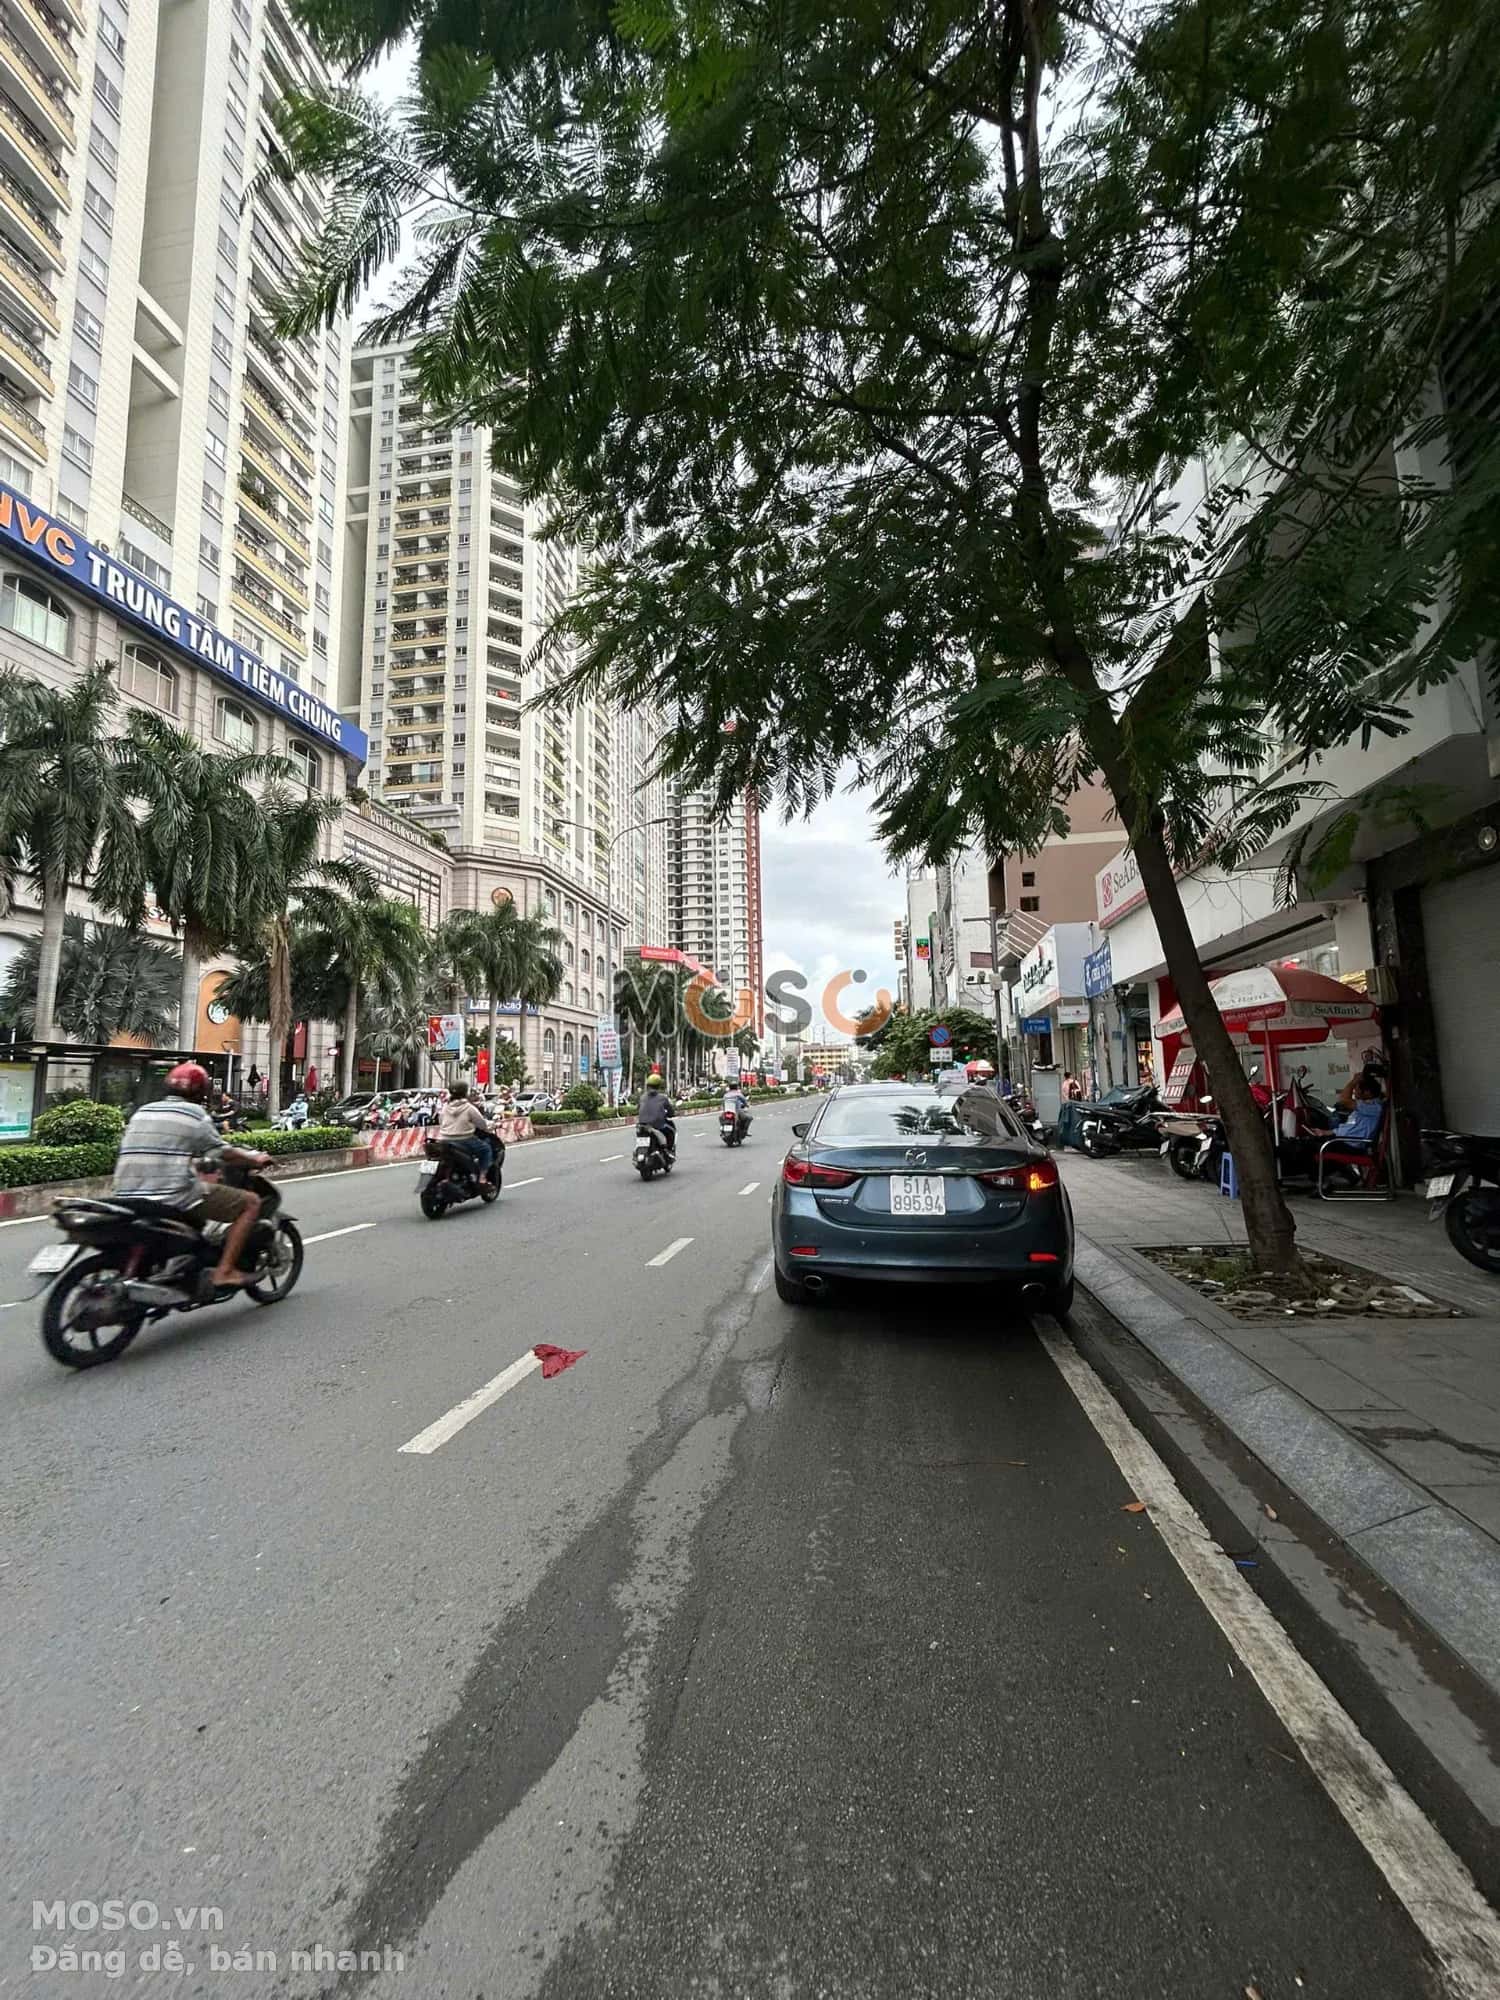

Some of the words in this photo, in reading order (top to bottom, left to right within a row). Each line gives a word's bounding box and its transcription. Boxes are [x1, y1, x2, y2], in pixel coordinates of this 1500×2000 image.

[88, 551, 181, 638] TRUNG
[187, 618, 234, 673] TÂM
[1314, 1004, 1361, 1016] SeABank
[904, 1178, 931, 1194] 51A
[894, 1195, 943, 1212] 895.94
